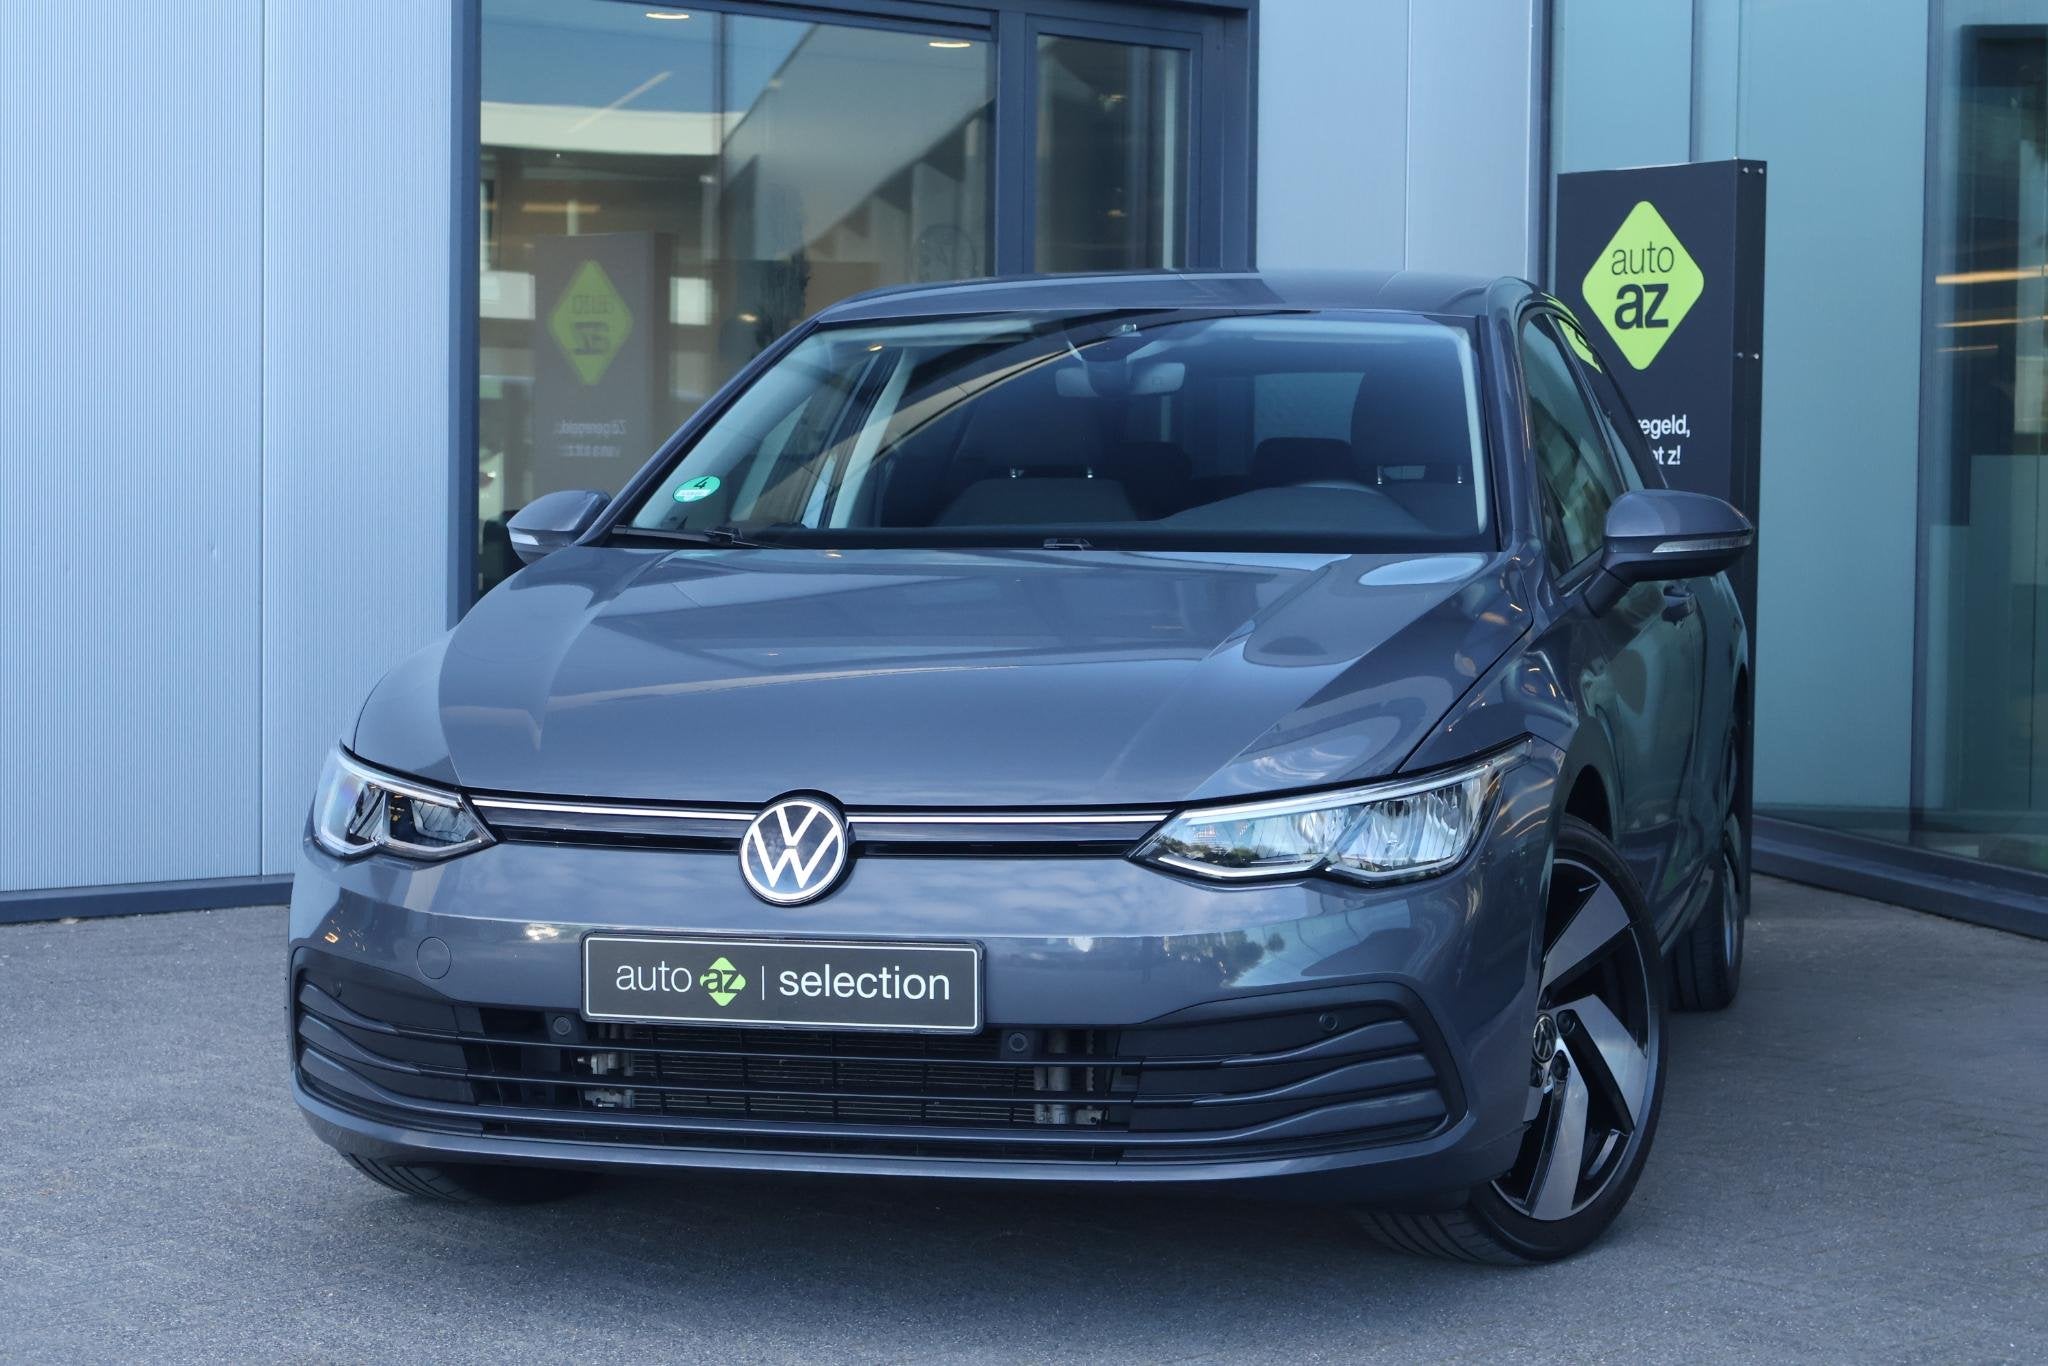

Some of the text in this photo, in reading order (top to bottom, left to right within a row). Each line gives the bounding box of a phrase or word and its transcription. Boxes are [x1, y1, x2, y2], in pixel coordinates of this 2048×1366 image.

[1611, 241, 1675, 276] auto
[1614, 283, 1669, 330] az
[1637, 414, 1691, 439] egeld,
[1667, 445, 1681, 465] z!
[694, 476, 708, 489] 4
[616, 960, 950, 1000] auto az selection
